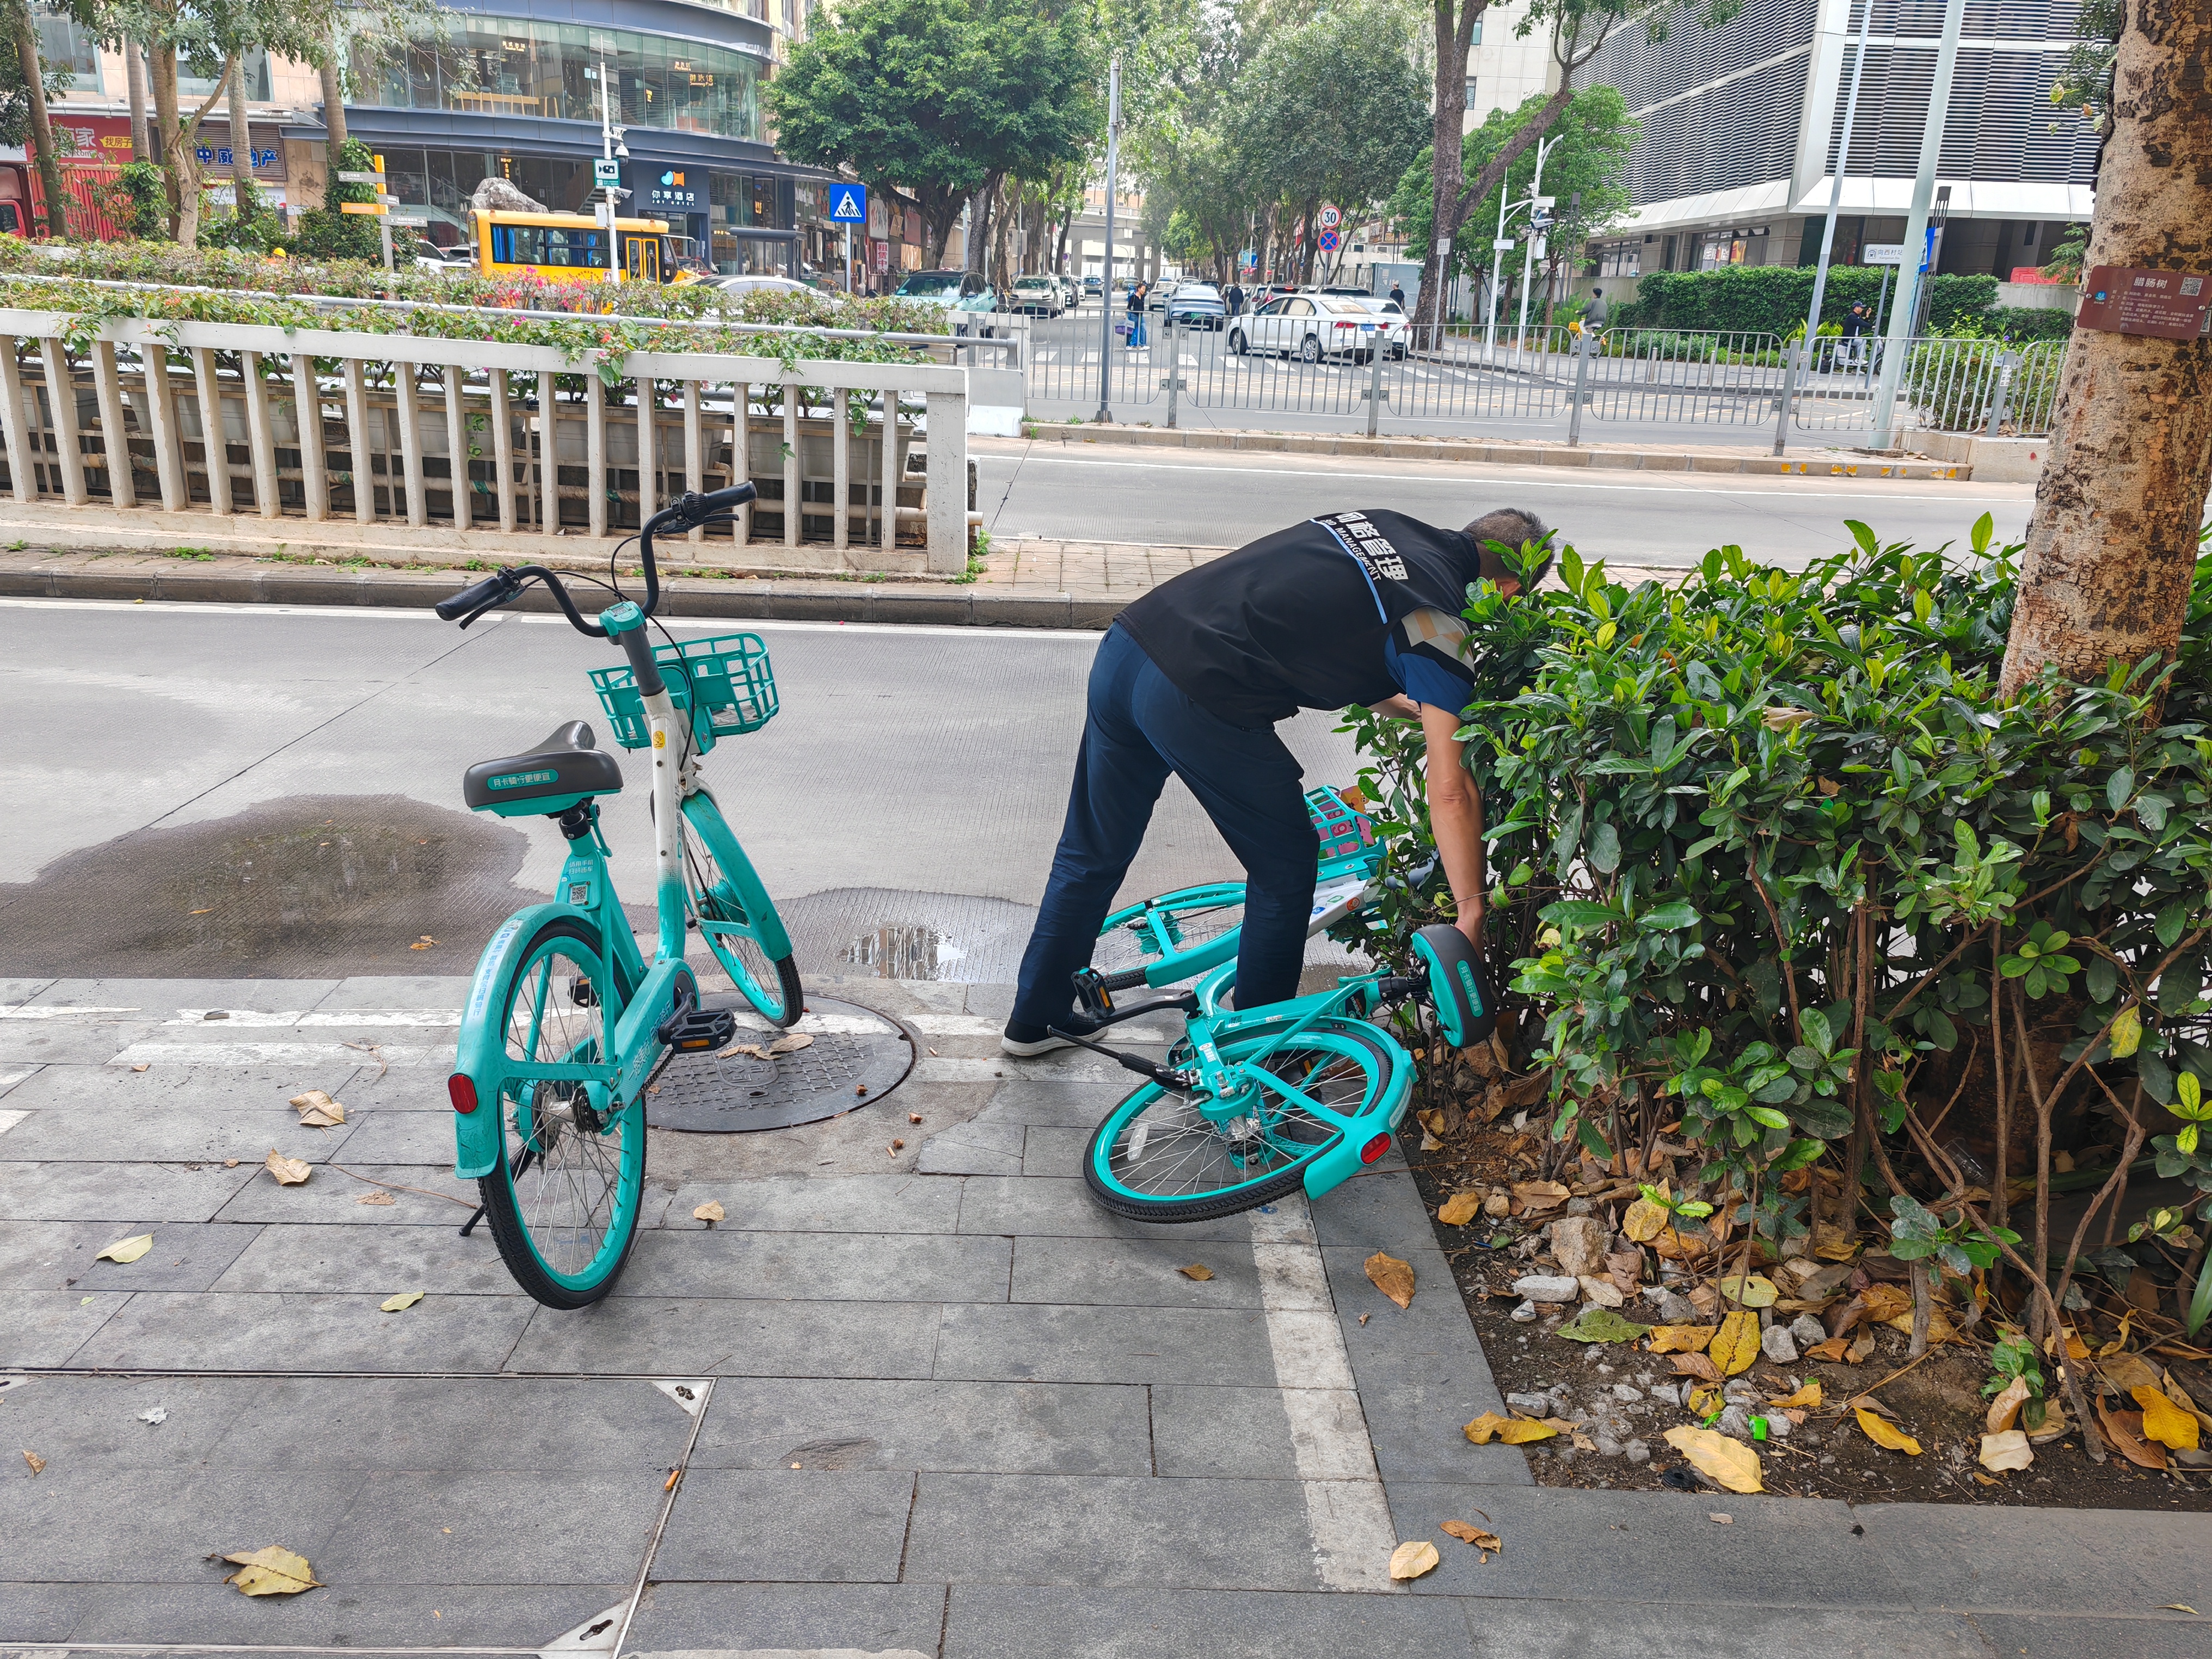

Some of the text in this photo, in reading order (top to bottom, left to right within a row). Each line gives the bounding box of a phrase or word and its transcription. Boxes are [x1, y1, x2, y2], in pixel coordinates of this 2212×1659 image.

[1325, 212, 1336, 223] 30
[2134, 276, 2168, 289] 腊肠树
[1335, 512, 1409, 580] 网格管理
[1335, 527, 1381, 581] MANAGEMENT
[493, 772, 551, 787] 月卡骑行更便宜
[1460, 966, 1481, 1012] 月卡骑行更便宜
